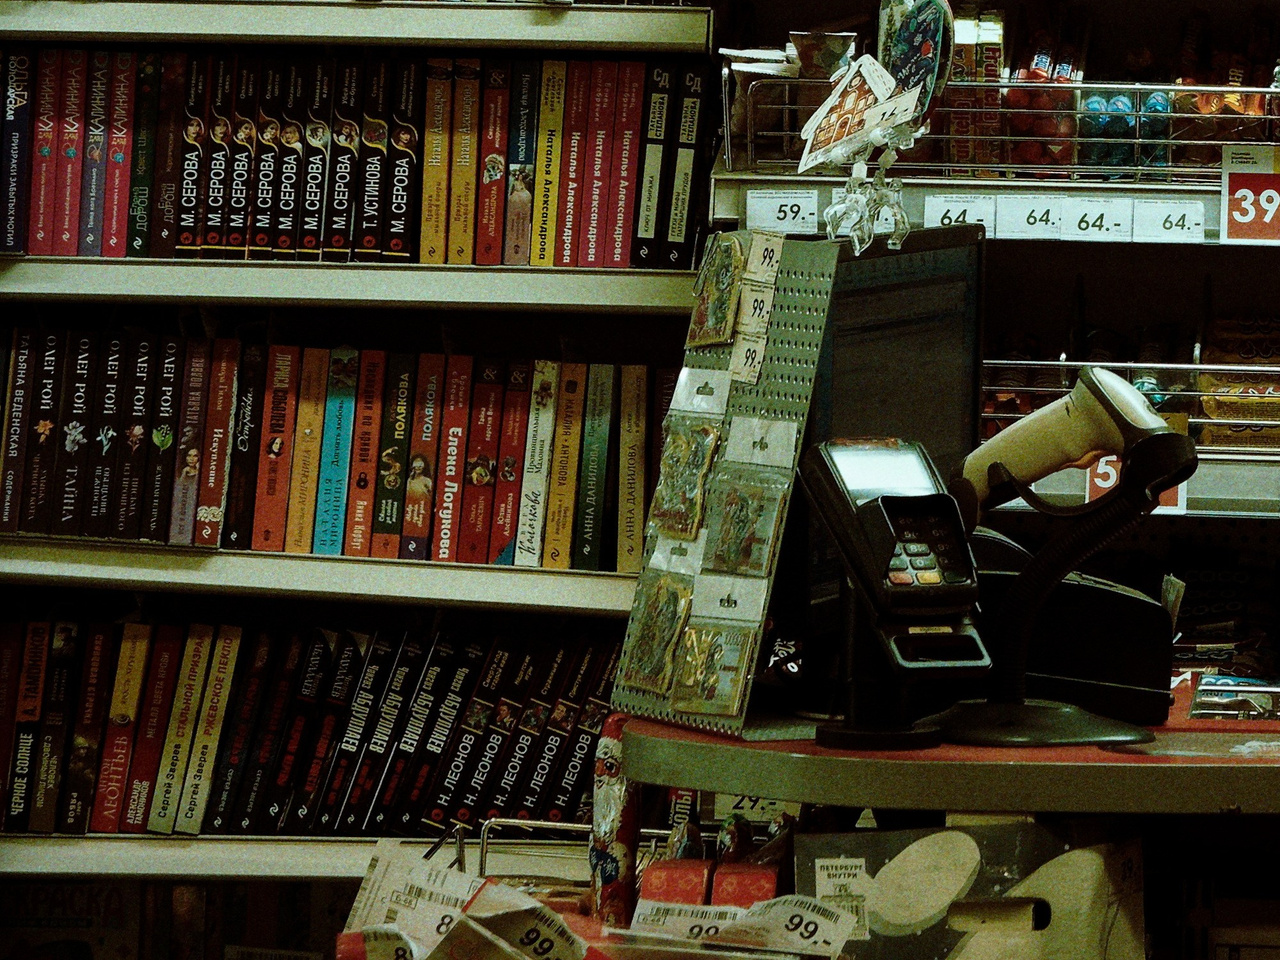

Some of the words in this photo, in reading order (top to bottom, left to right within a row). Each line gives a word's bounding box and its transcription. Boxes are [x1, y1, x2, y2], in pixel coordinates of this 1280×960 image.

[64, 68, 80, 133] КАЛИНИНА
[655, 96, 667, 138] СТЕПАНОВА
[545, 129, 556, 175] Наталья
[181, 151, 199, 208] СЕРОВА
[362, 156, 381, 218] УСТИНОВА
[136, 187, 149, 232] ДОРОШ
[180, 211, 195, 227] М.
[362, 217, 378, 229] Т.
[539, 179, 553, 260] Александрова
[776, 204, 815, 221] 59.-
[1078, 212, 1122, 234] 64.-
[761, 247, 780, 269] 99.-
[76, 338, 90, 378] ОЛЕГ
[72, 383, 86, 414] РОЙ
[394, 373, 410, 440] ПОЛЯКОВА
[8, 389, 25, 458] ВЕДЕНСКАЯ
[208, 428, 224, 488] Искупление
[445, 427, 463, 476] Елена
[585, 443, 599, 507] ДАНИЛОВА
[61, 465, 78, 522] ТАЙНА
[434, 481, 459, 559] Логунова
[583, 508, 595, 540] АННА
[204, 683, 225, 737] РЖЕВСКОЕ
[216, 637, 234, 682] ПЕКЛО
[399, 691, 435, 753] АБДУЛЛАЕВ
[10, 777, 28, 816] ЧЕРНОЕ
[20, 731, 33, 774] СОЛНЦЕ
[102, 735, 129, 820] ЛЕОНТЬЕВ
[443, 733, 475, 791] ЛЕОНОВ
[436, 790, 453, 806] Н.
[819, 863, 864, 873] ПЕТЕРБУРГ
[826, 871, 858, 880] ВНУТРИ
[784, 914, 831, 947] 99.-
